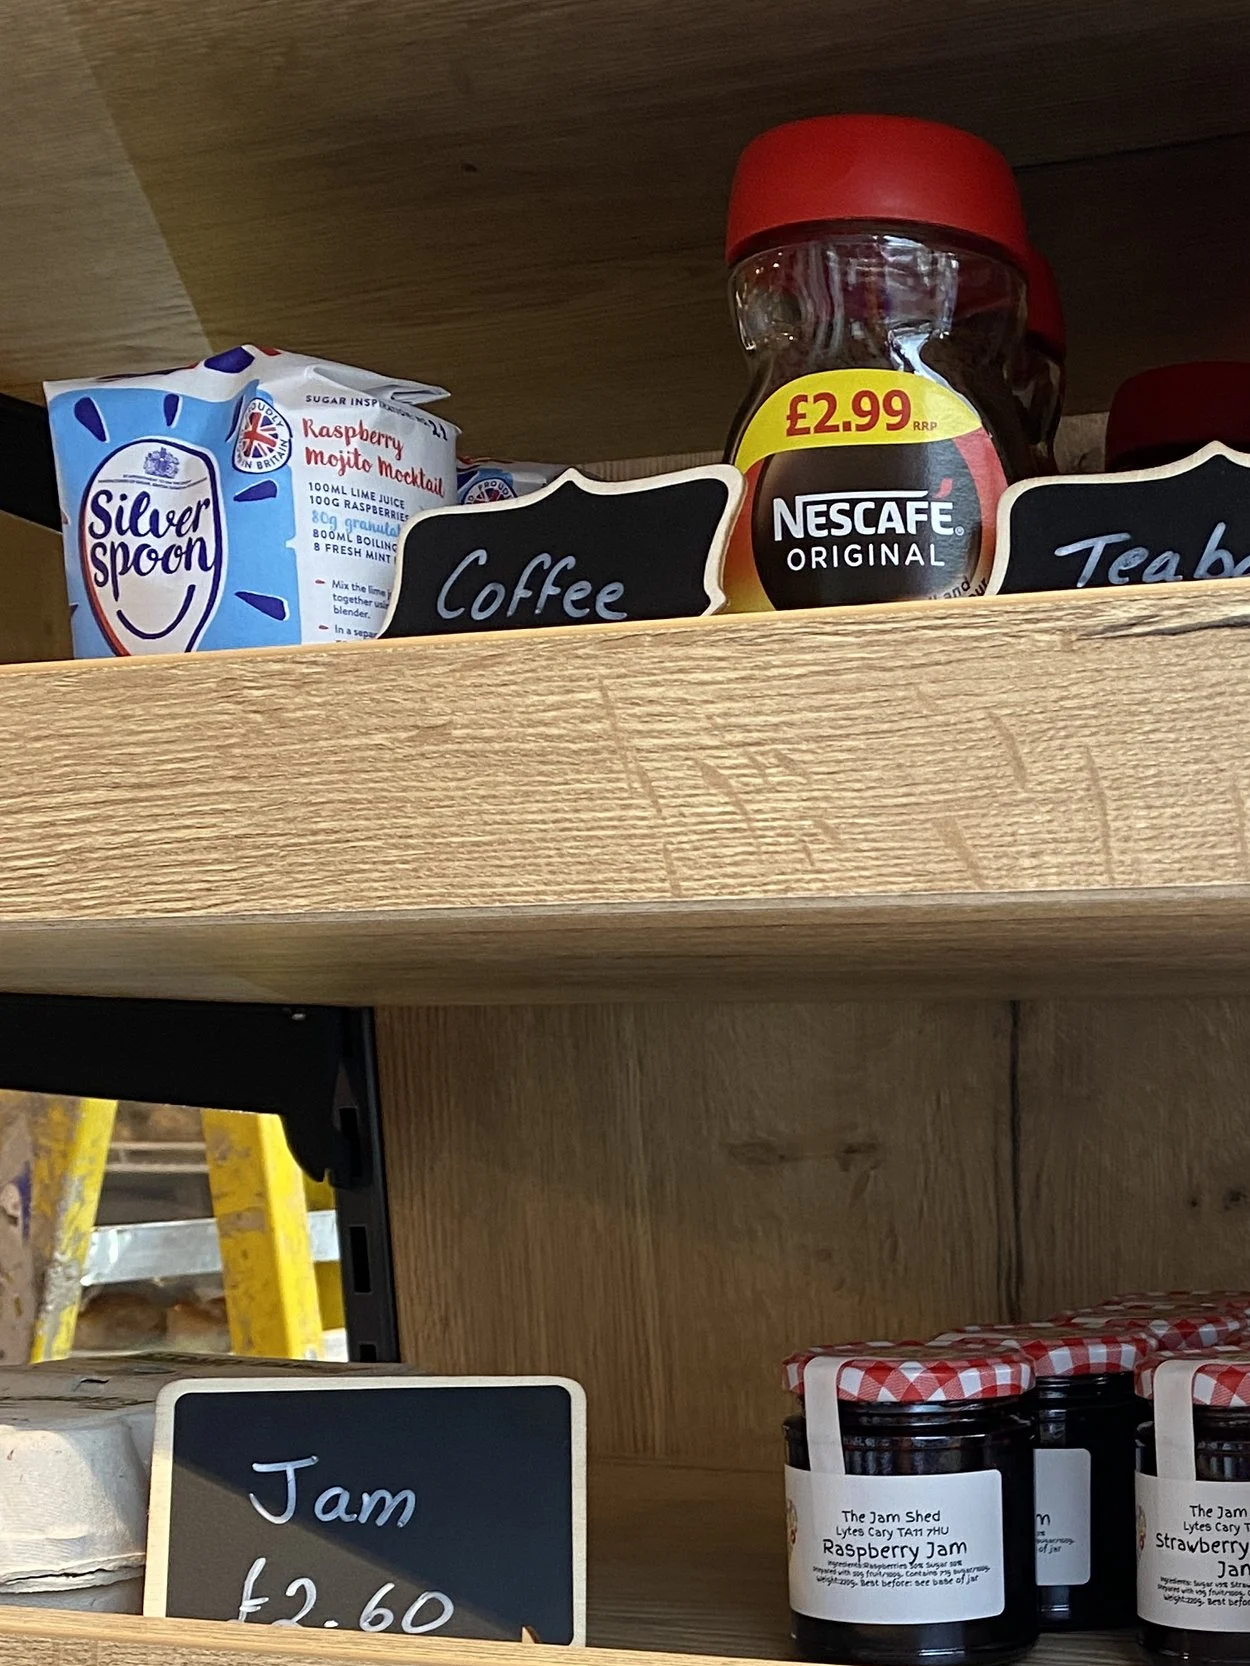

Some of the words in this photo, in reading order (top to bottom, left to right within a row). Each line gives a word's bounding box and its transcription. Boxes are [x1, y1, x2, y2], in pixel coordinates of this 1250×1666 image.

[306, 395, 346, 404] SUGAR
[786, 390, 911, 436] £2.99
[913, 421, 937, 431] RRP
[303, 418, 403, 460] Raspberry
[257, 439, 288, 470] BRITAIN
[305, 447, 372, 476] Mojito
[378, 456, 444, 497] Mocktail
[309, 482, 347, 495] 100ML
[351, 488, 376, 501] LIME
[379, 494, 405, 509] JUICE
[310, 496, 339, 507] 100G
[88, 490, 210, 539] Silver
[312, 510, 337, 531] 80g
[313, 529, 352, 542] 800ML
[314, 543, 320, 551] 8
[325, 544, 361, 557] FRESH
[366, 551, 391, 563] MINT
[787, 544, 944, 570] ORIGINAL
[90, 537, 215, 601] spoon
[332, 580, 349, 590] Mix
[352, 581, 366, 592] the
[436, 549, 626, 620] Coffee
[333, 594, 372, 605] together
[334, 605, 371, 619] blender.
[249, 1455, 416, 1528] Jam
[842, 1510, 865, 1523] The
[870, 1512, 900, 1524] Jam
[906, 1510, 940, 1522] Shed
[1190, 1504, 1213, 1518] The
[1217, 1506, 1247, 1519] Jam
[836, 1527, 864, 1539] Lytes
[868, 1527, 893, 1540] Cary
[1184, 1521, 1211, 1534] Lytes
[1215, 1522, 1240, 1535] Cary
[823, 1539, 919, 1565] Raspberry
[927, 1541, 967, 1559] Jam
[226, 1557, 454, 1634] £2.60
